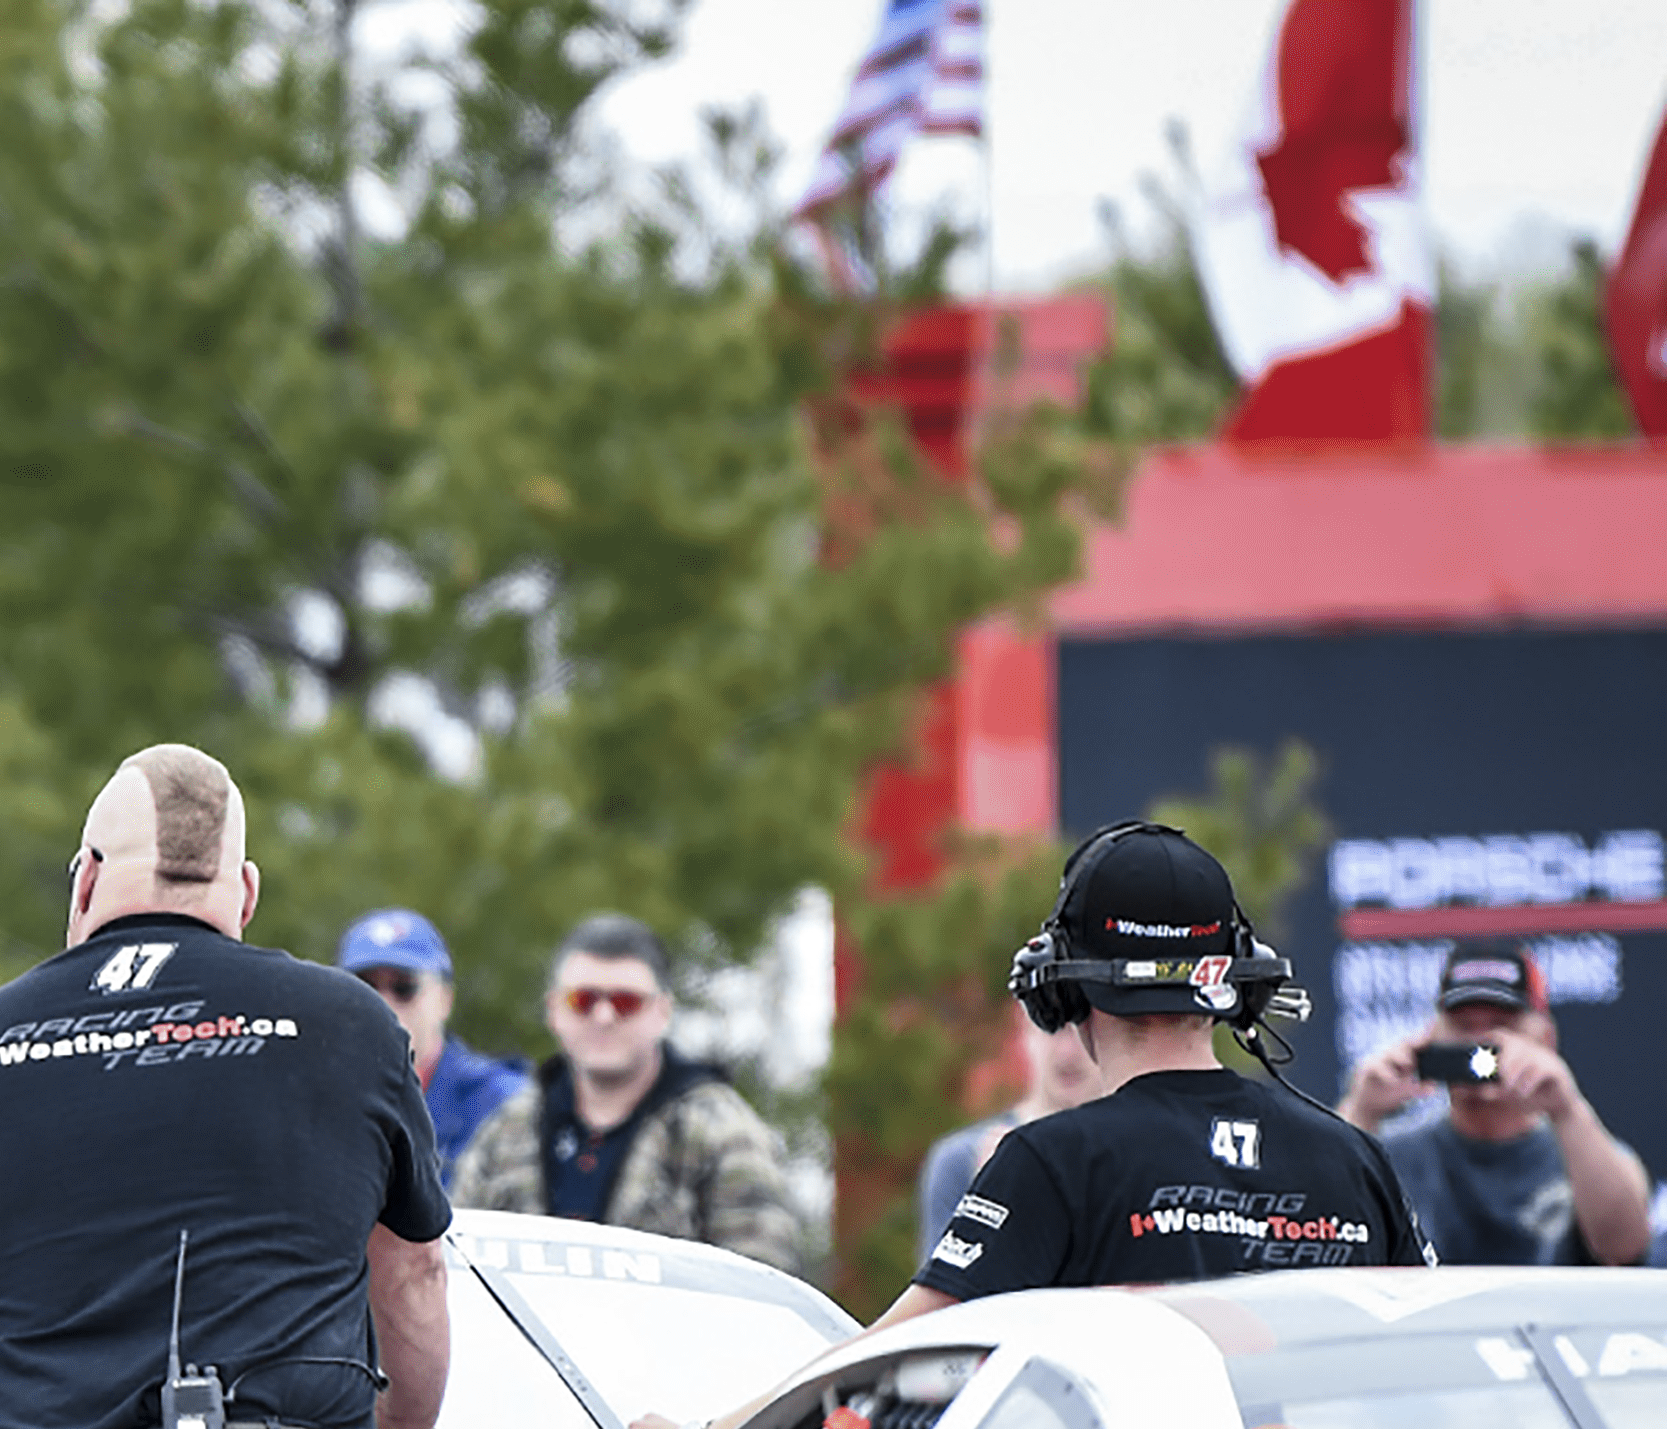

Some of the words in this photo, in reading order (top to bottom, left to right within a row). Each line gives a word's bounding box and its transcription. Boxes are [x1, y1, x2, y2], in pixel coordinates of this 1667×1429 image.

[90, 942, 179, 995] 47
[1194, 956, 1229, 986] 47
[102, 1036, 266, 1071] TEAM
[1211, 1116, 1261, 1170] 47
[1148, 1185, 1307, 1213] RACING
[1240, 1238, 1354, 1264] TEAM
